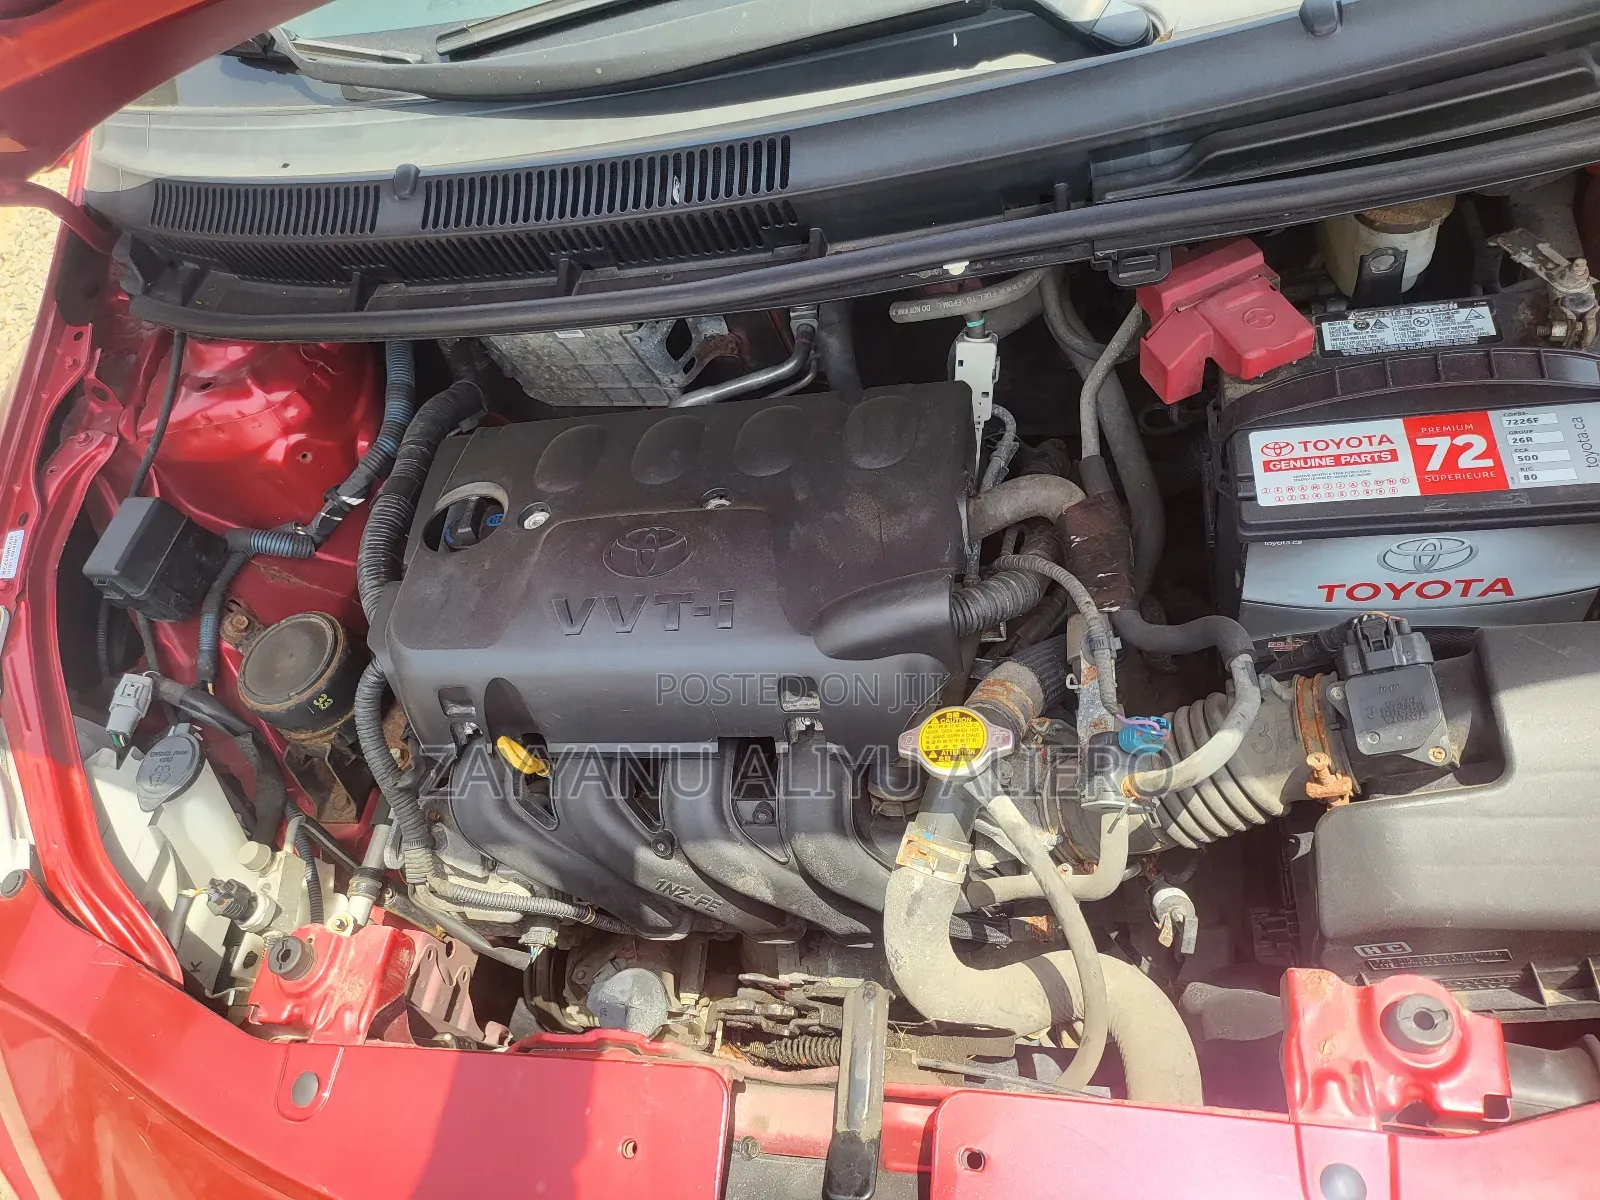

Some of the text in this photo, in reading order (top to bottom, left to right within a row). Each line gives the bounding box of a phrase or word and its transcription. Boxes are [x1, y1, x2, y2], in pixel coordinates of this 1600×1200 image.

[1421, 424, 1474, 433] PREMIUM
[1505, 417, 1539, 426] 7226F
[1298, 434, 1395, 452] TOYOTA
[1571, 416, 1600, 468] toyota.ca
[1269, 452, 1392, 470] GENUINE PARTS
[1415, 434, 1495, 472] 72
[1424, 472, 1496, 483] SUPERIEURE
[1317, 578, 1514, 602] TOYOTA
[551, 589, 736, 636] VVT-i
[655, 878, 723, 912] 1NZ-FE
